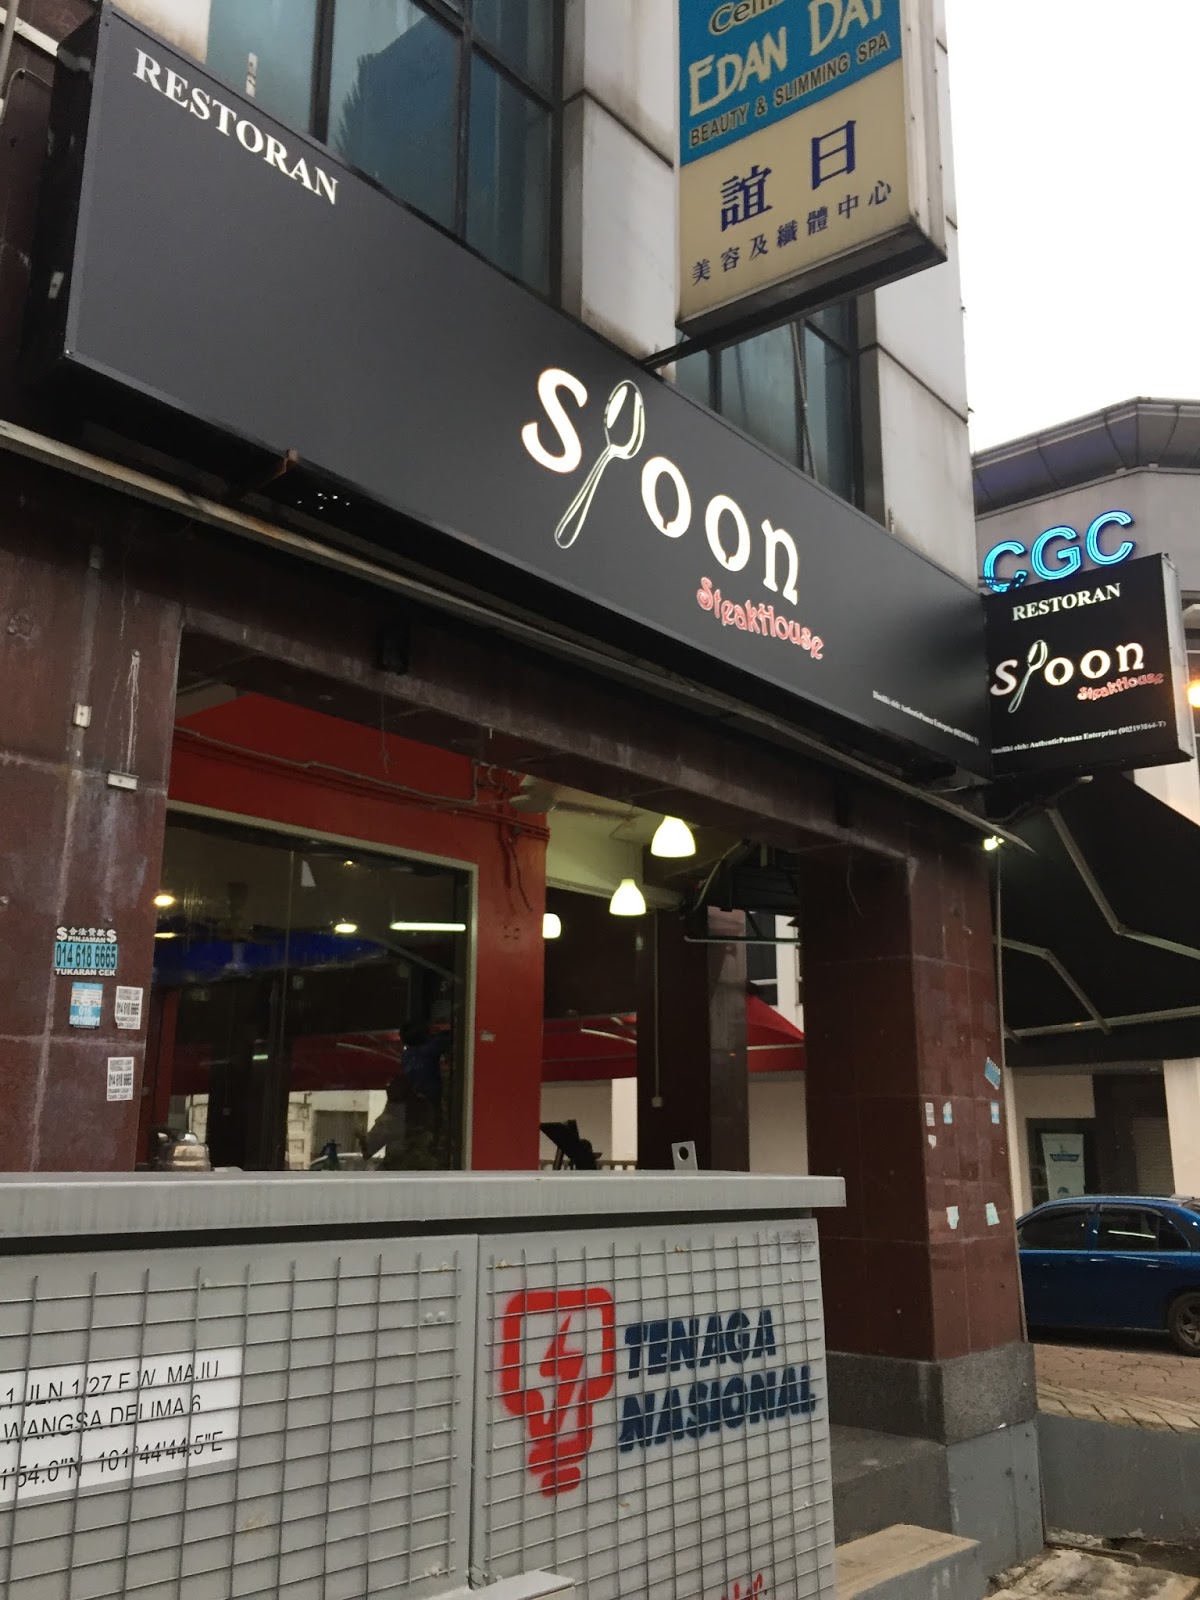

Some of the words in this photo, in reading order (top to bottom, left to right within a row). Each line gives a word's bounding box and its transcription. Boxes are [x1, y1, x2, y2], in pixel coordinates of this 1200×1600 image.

[689, 26, 787, 117] EDAN
[690, 104, 748, 147] BEAUTY
[756, 96, 767, 116] &
[774, 54, 850, 107] SLIMMING
[857, 31, 890, 64] SPA
[133, 47, 339, 205] RESTORAN
[983, 510, 1134, 593] CGC
[1012, 583, 1121, 621] RESTORAN
[55, 968, 97, 976] TUKARAN
[56, 944, 73, 967] 014
[75, 945, 92, 967] 618
[94, 945, 116, 968] 6665
[67, 935, 106, 943] PINJAMAN
[624, 1310, 777, 1379] TENAGA
[4, 1410, 103, 1444] WANGSA
[110, 1397, 184, 1428] DELIMA
[619, 1365, 816, 1453] NASIONAL
